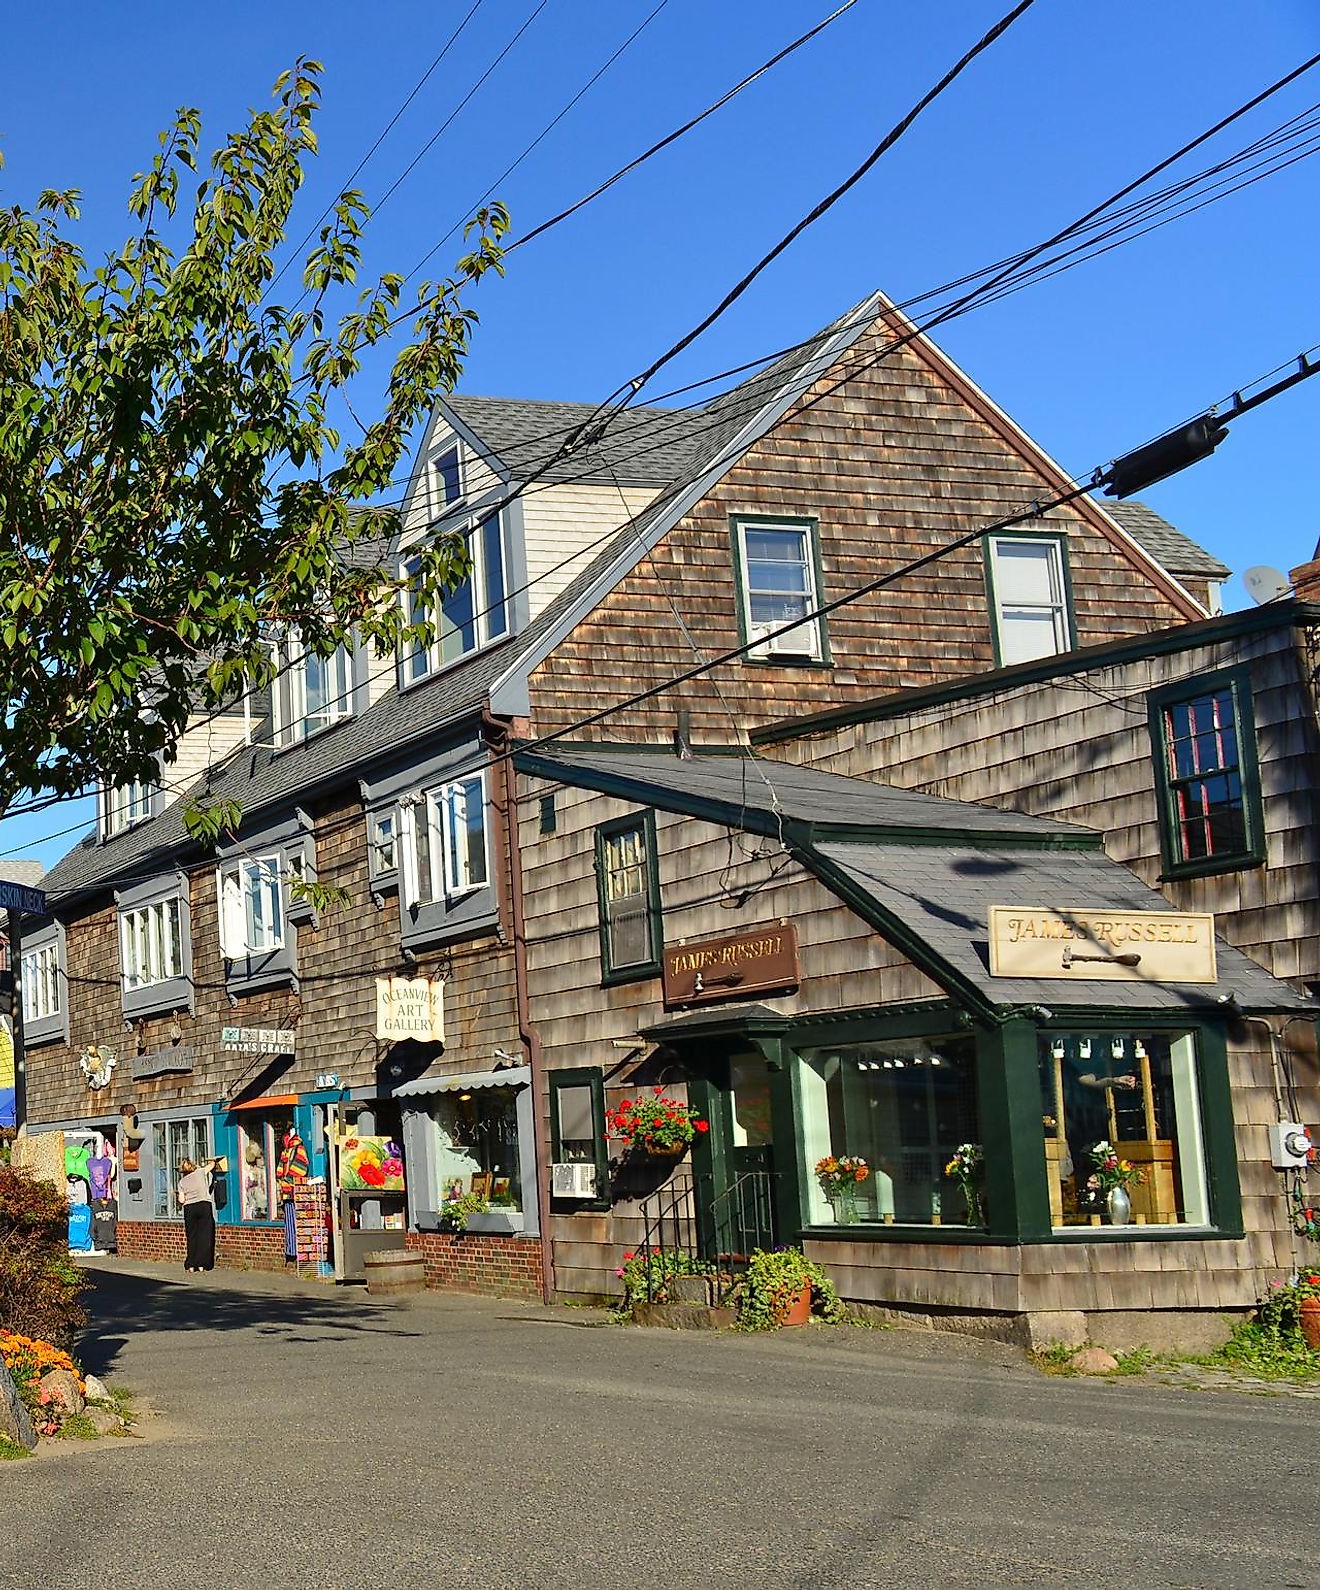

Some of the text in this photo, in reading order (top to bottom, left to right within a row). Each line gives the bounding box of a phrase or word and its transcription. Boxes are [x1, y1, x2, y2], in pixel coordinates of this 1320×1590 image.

[1009, 919, 1198, 948] JAMES RUSSELL
[670, 937, 783, 976] JAMES RUSSELL
[382, 988, 439, 1006] OCEANVIEW
[397, 1005, 423, 1017] ART
[384, 1018, 436, 1031] GALLERY
